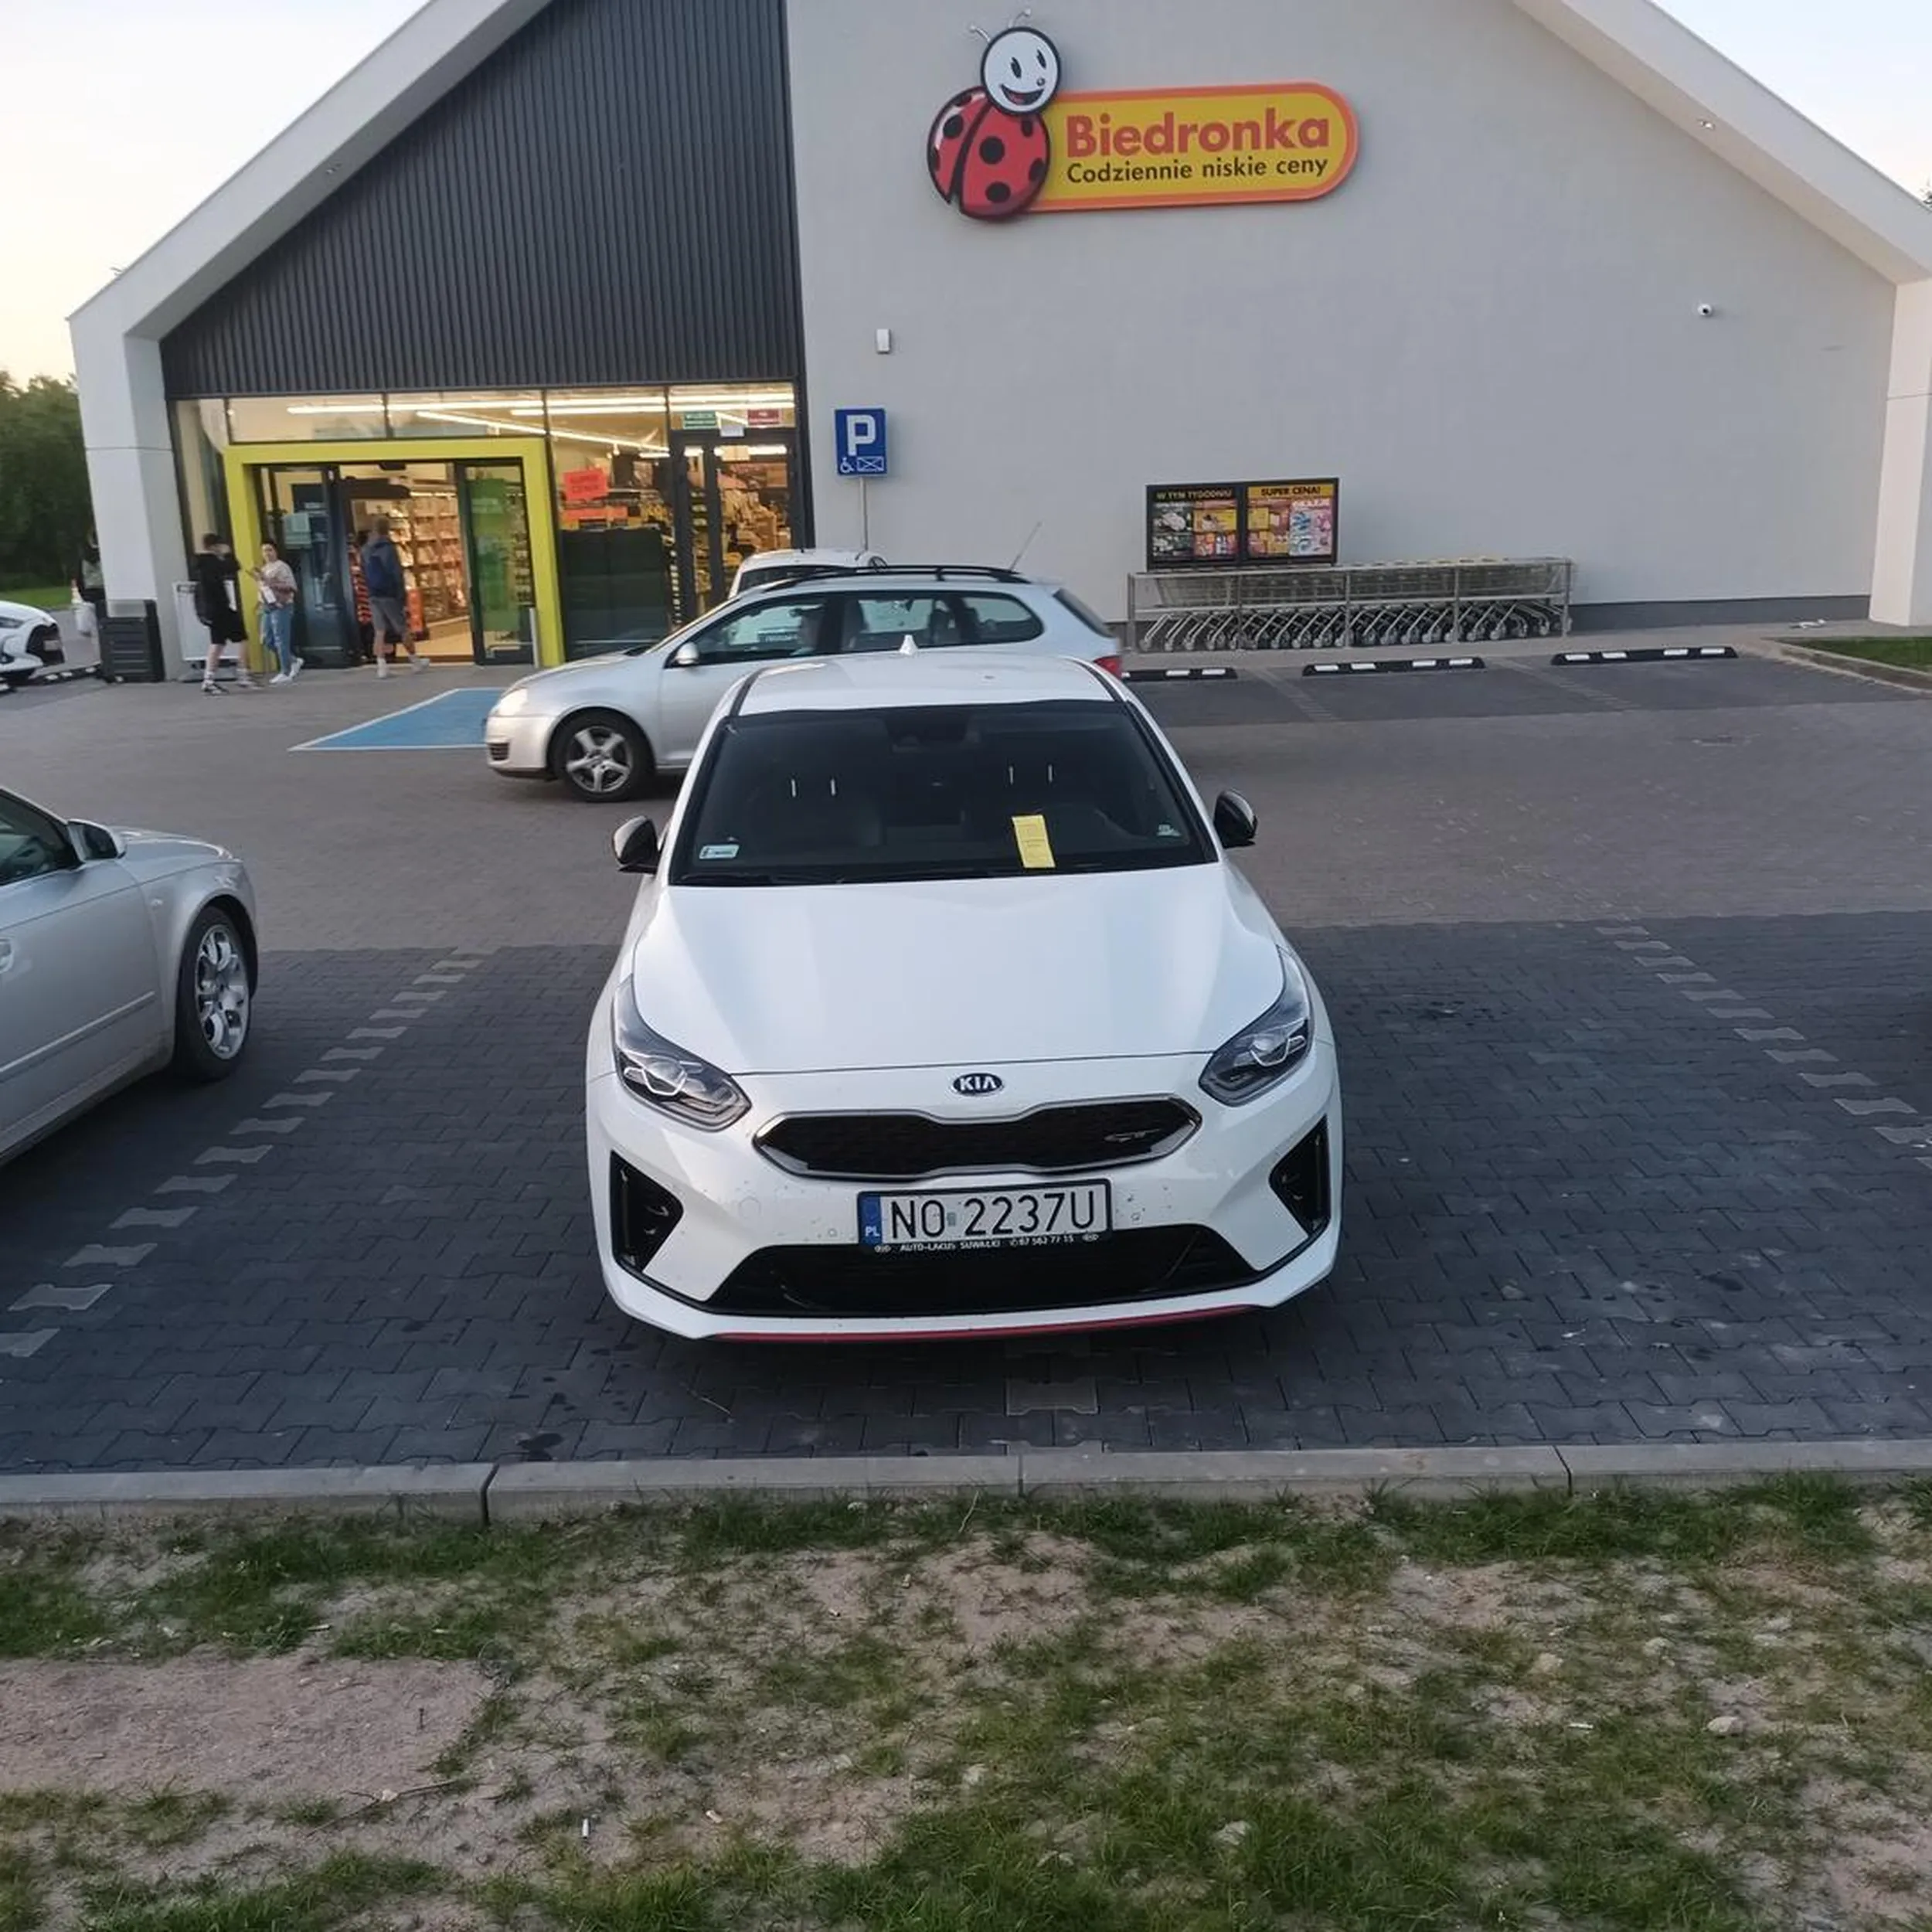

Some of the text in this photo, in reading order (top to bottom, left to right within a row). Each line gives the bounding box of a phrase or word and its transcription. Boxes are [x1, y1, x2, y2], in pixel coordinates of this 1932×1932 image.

[1066, 109, 1329, 158] Biedronka
[1066, 156, 1328, 183] Codziennie niskie ceny
[847, 414, 876, 456] P
[1260, 488, 1289, 496] SUPER
[960, 1076, 997, 1090] KIA
[891, 1190, 1094, 1240] NO 2237U
[865, 1226, 880, 1237] PL
